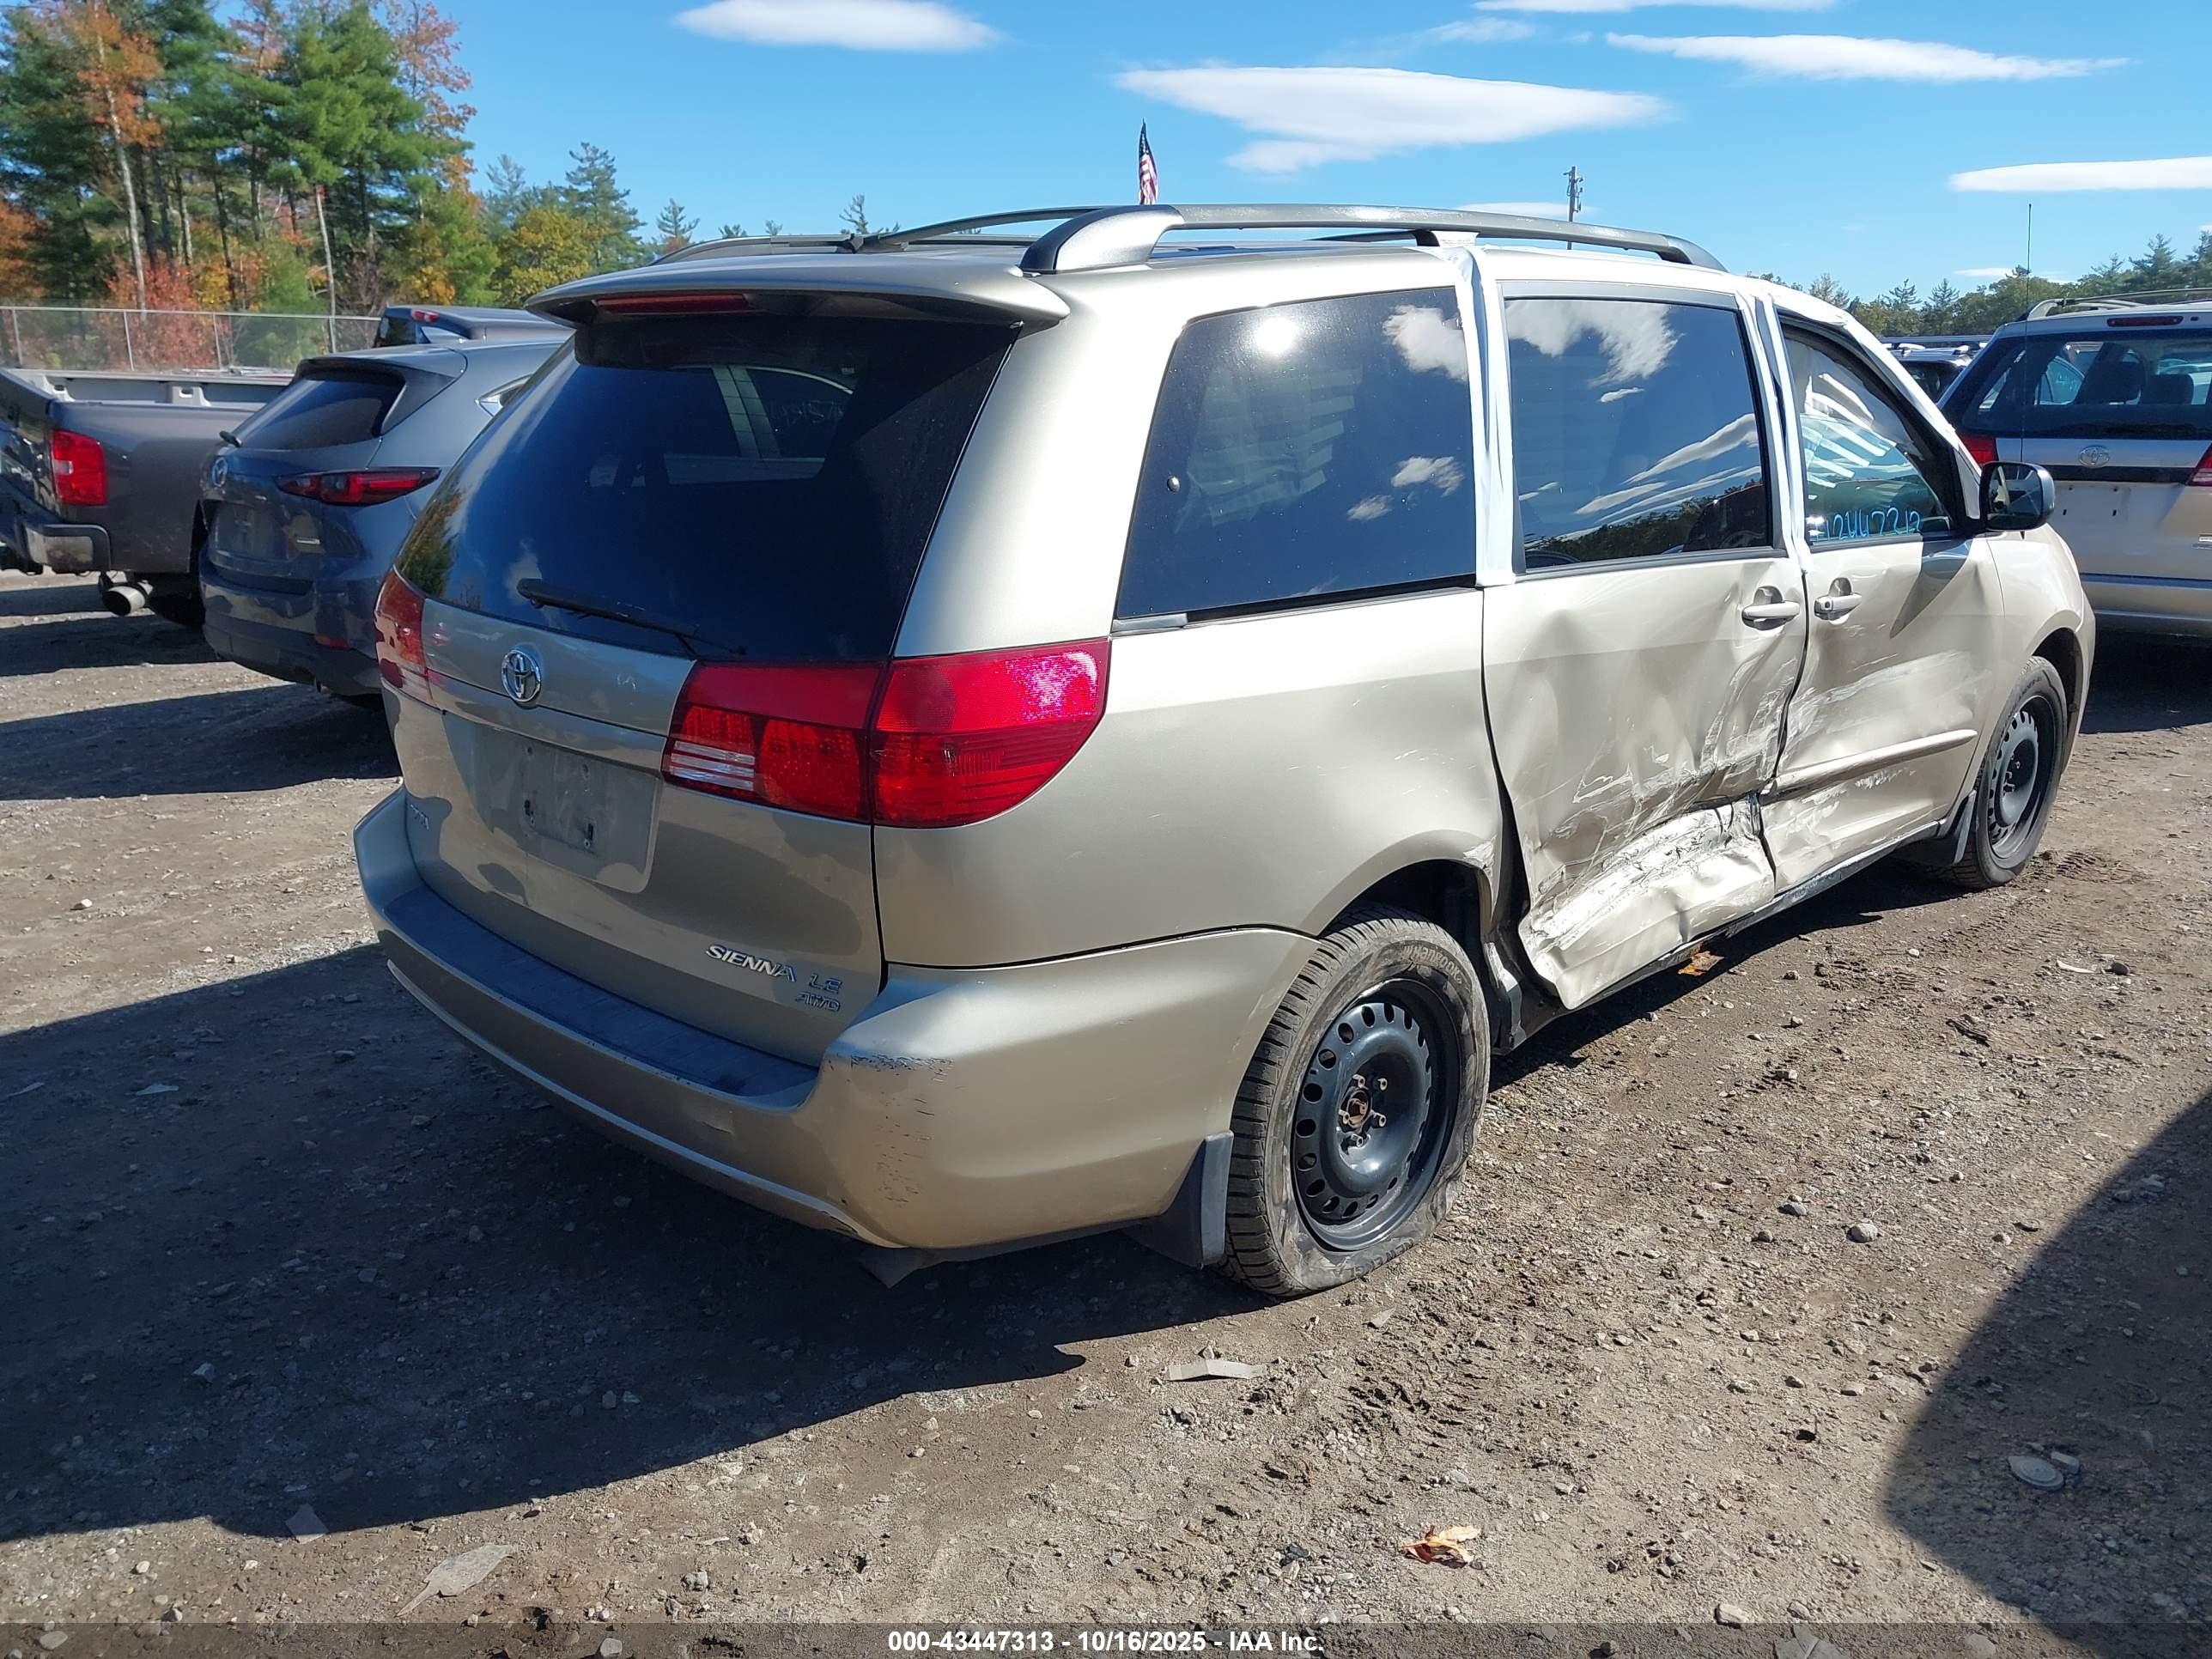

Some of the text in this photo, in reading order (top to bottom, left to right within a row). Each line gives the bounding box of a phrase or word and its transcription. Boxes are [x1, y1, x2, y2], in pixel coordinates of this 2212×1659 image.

[706, 945, 842, 994] SIENNA LE
[796, 991, 842, 1012] AWD
